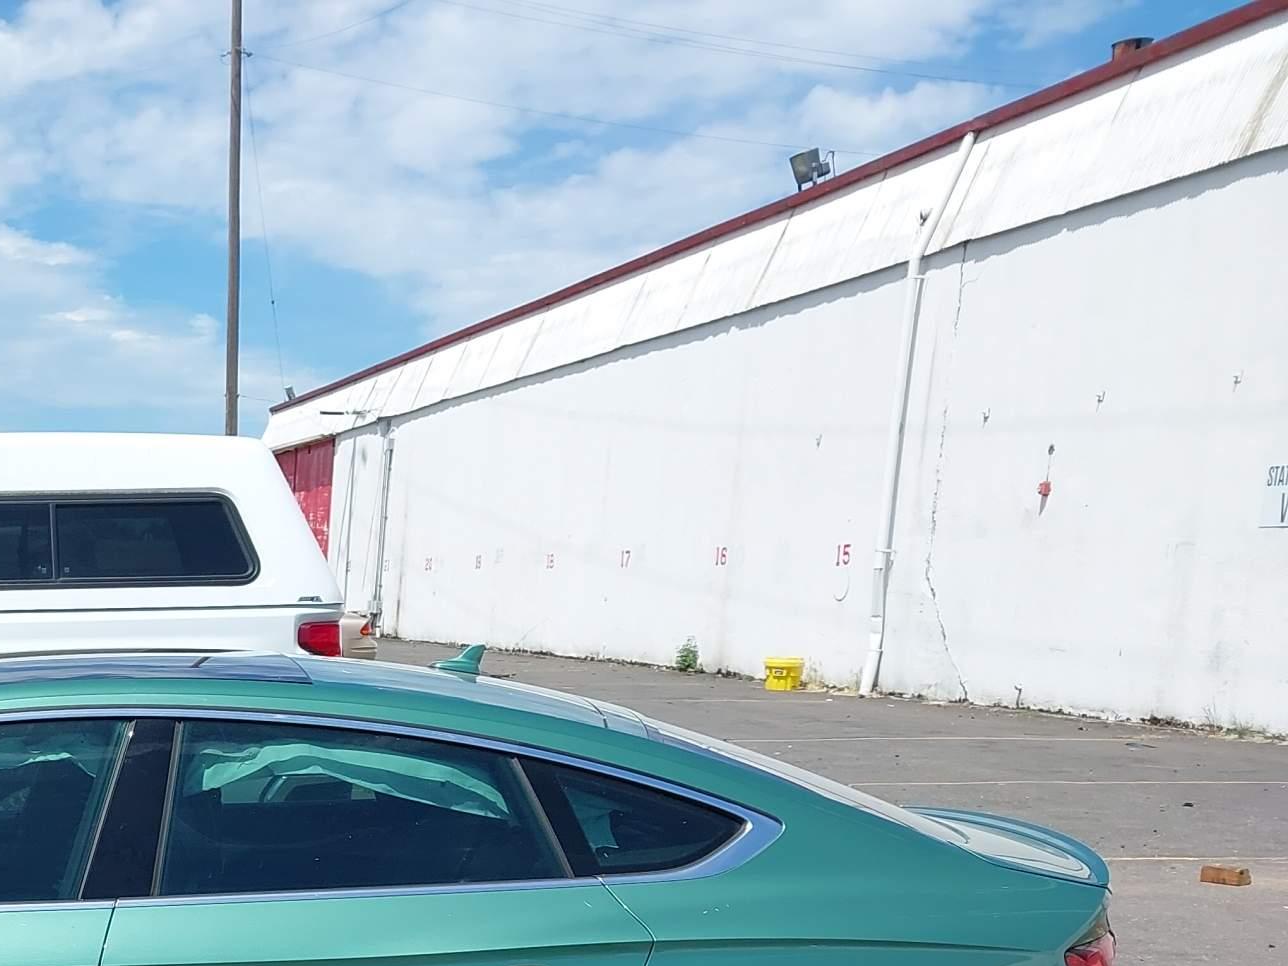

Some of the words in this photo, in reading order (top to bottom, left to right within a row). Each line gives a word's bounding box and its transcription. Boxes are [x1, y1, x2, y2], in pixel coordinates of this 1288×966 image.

[621, 550, 631, 568] 17
[715, 546, 728, 566] 16
[836, 543, 852, 567] 15
